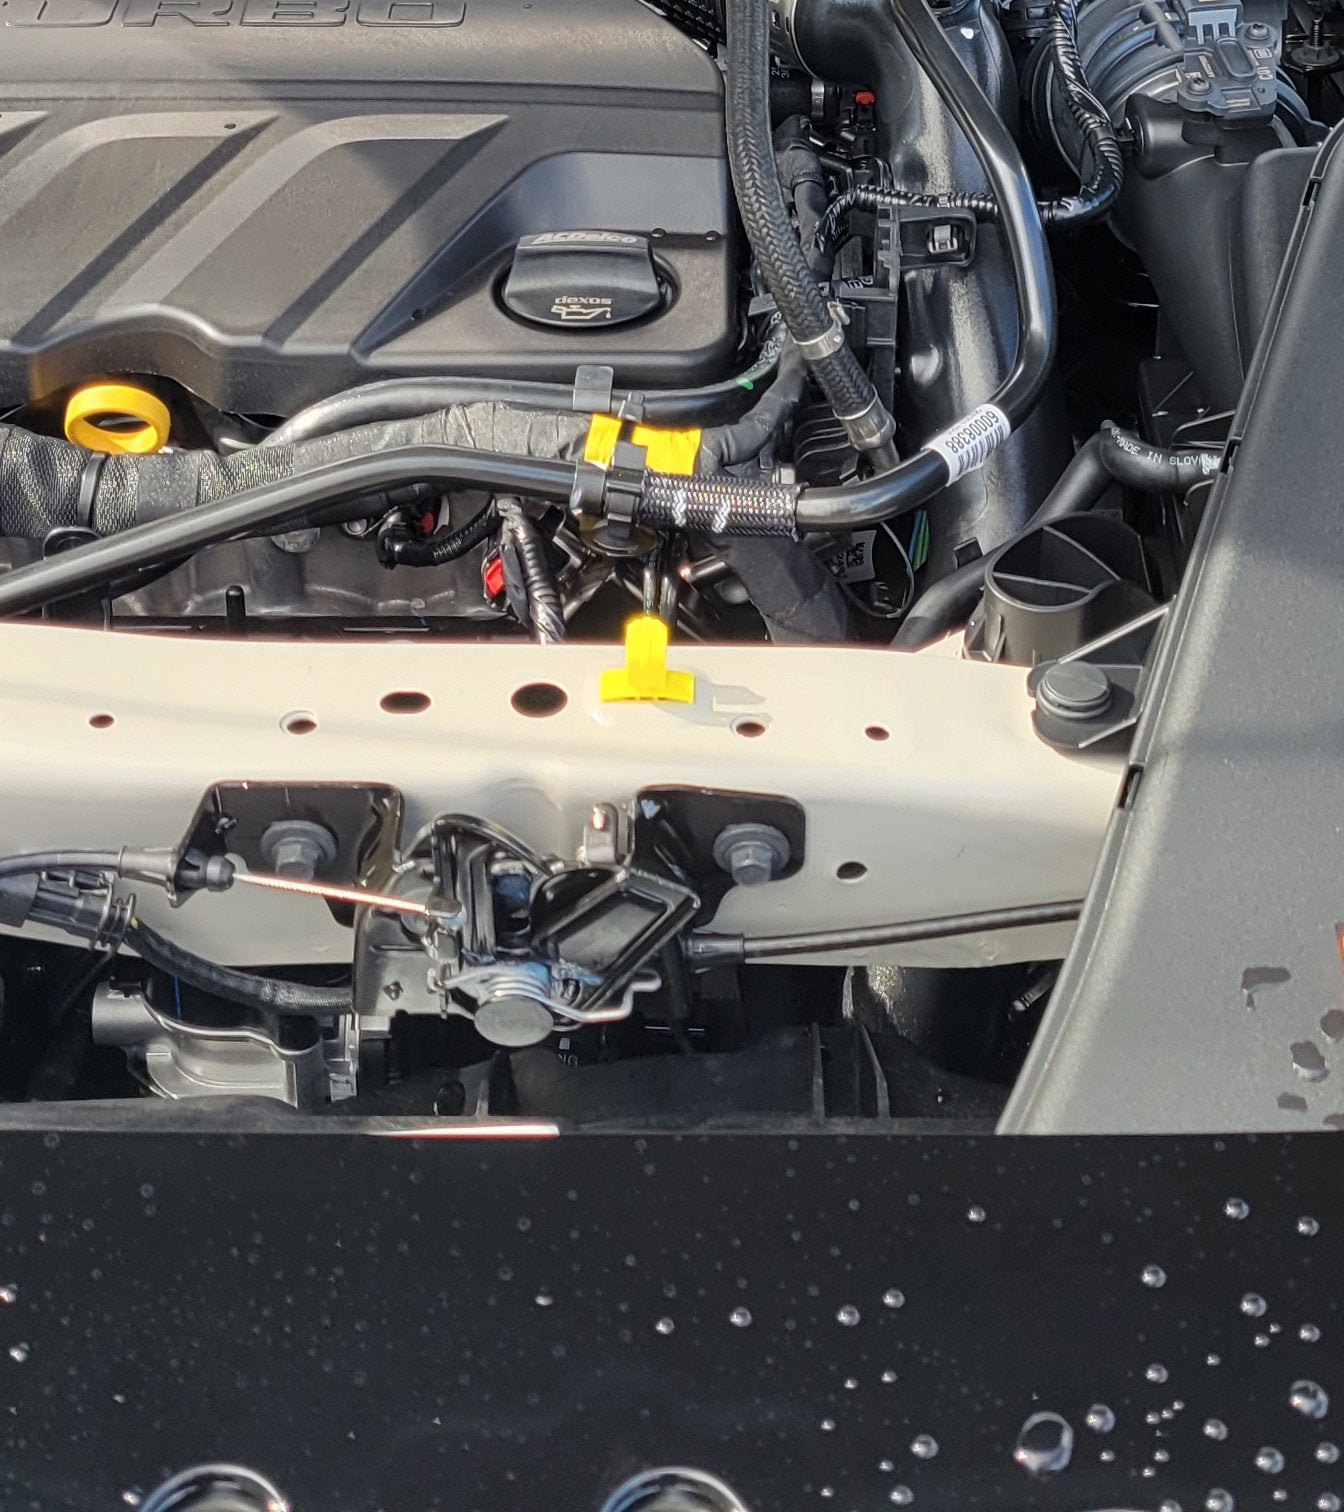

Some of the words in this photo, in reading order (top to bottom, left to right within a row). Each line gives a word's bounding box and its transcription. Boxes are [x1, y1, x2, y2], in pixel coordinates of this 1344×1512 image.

[531, 231, 638, 245] ACDelco
[555, 296, 612, 305] dexos
[945, 410, 1000, 454] 60008388
[1147, 450, 1163, 464] IN
